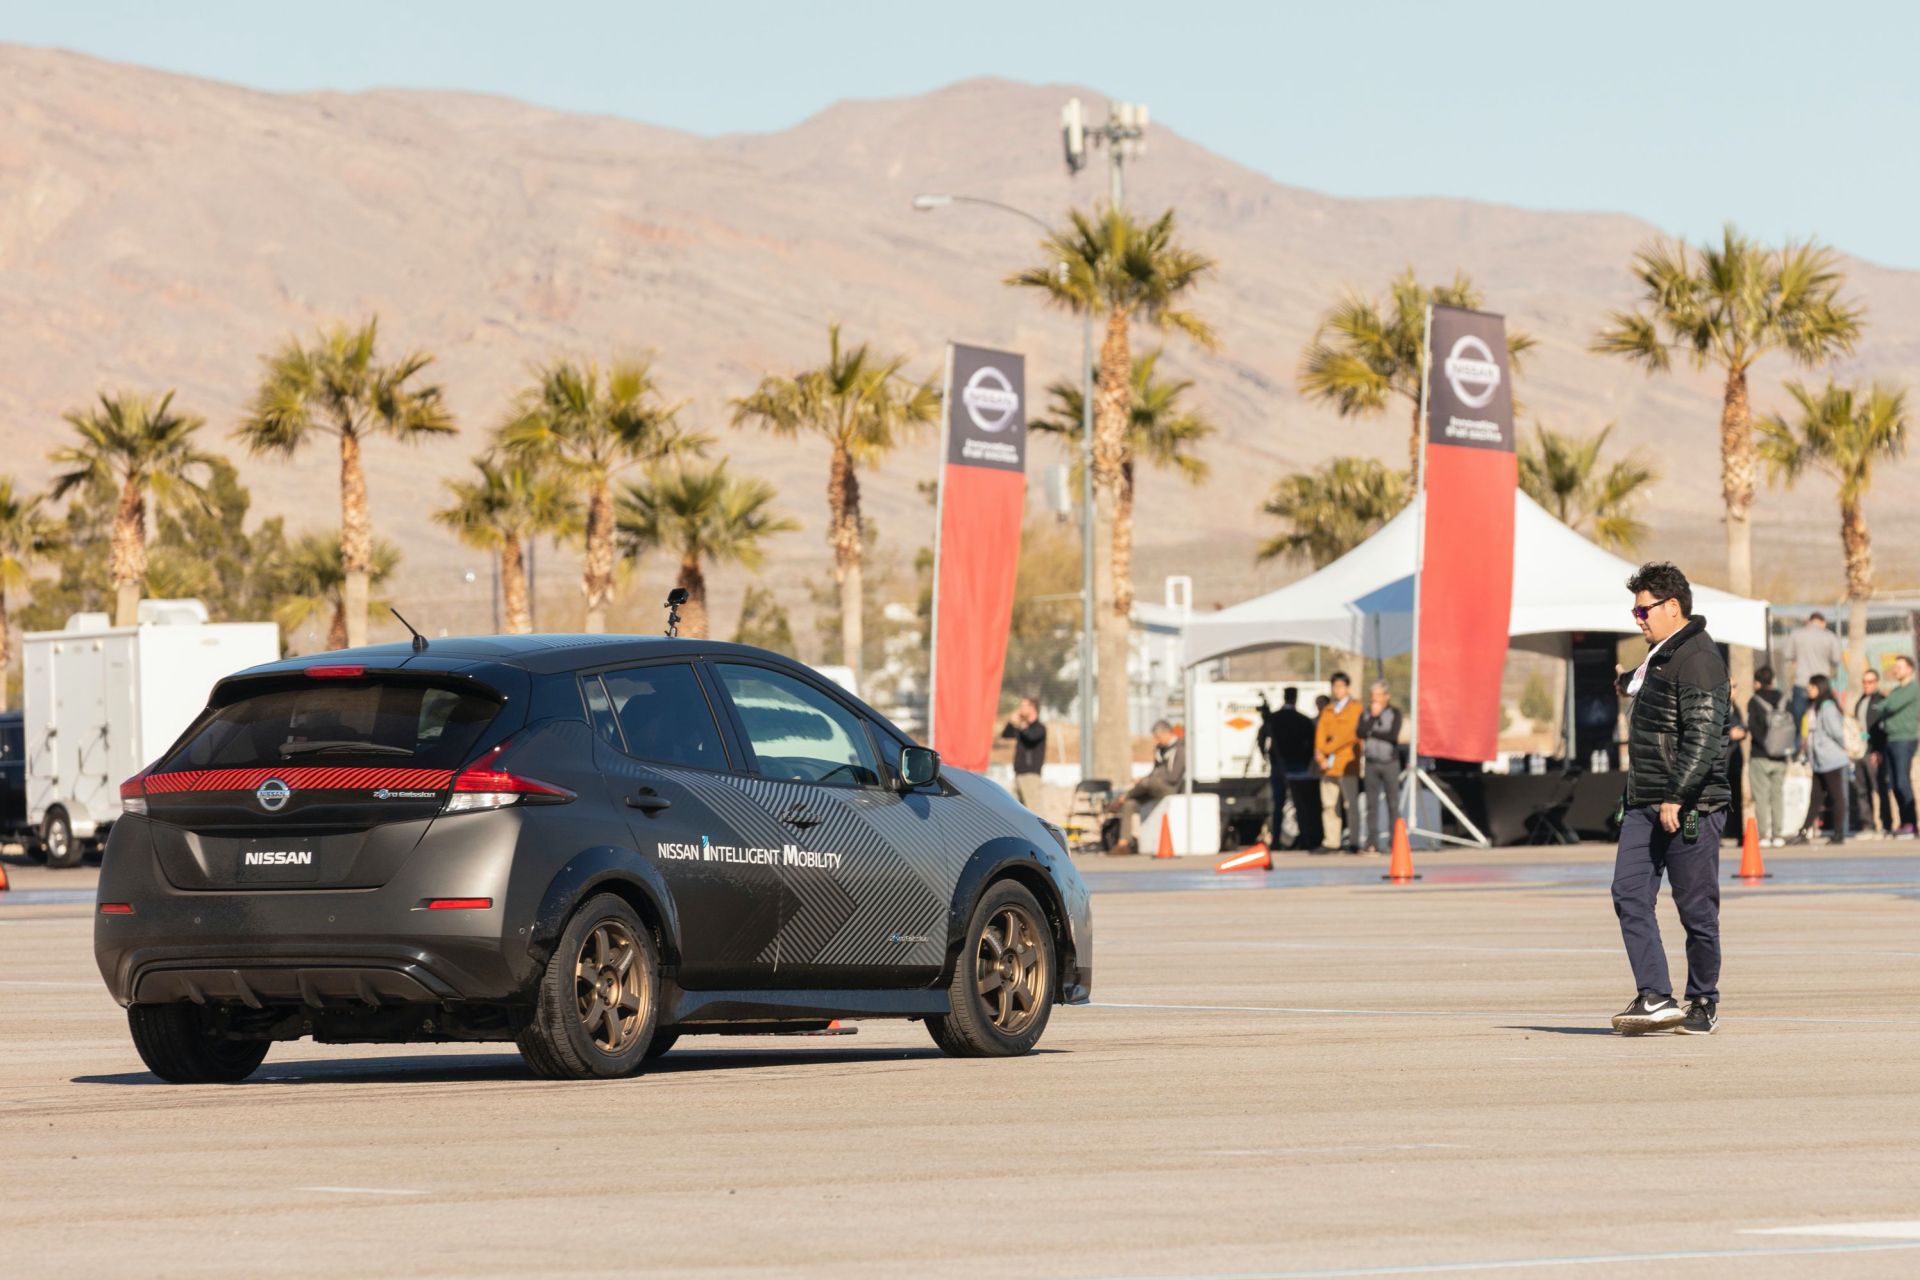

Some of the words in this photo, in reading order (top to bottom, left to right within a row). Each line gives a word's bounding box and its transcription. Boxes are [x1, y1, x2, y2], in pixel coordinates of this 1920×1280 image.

[1452, 363, 1495, 377] NISSAN
[970, 392, 1012, 405] NISSAN
[245, 851, 312, 865] NISSAN
[657, 842, 700, 861] NISSAN
[701, 835, 780, 865] INTELLIGENT
[782, 844, 842, 869] MOBILITY
